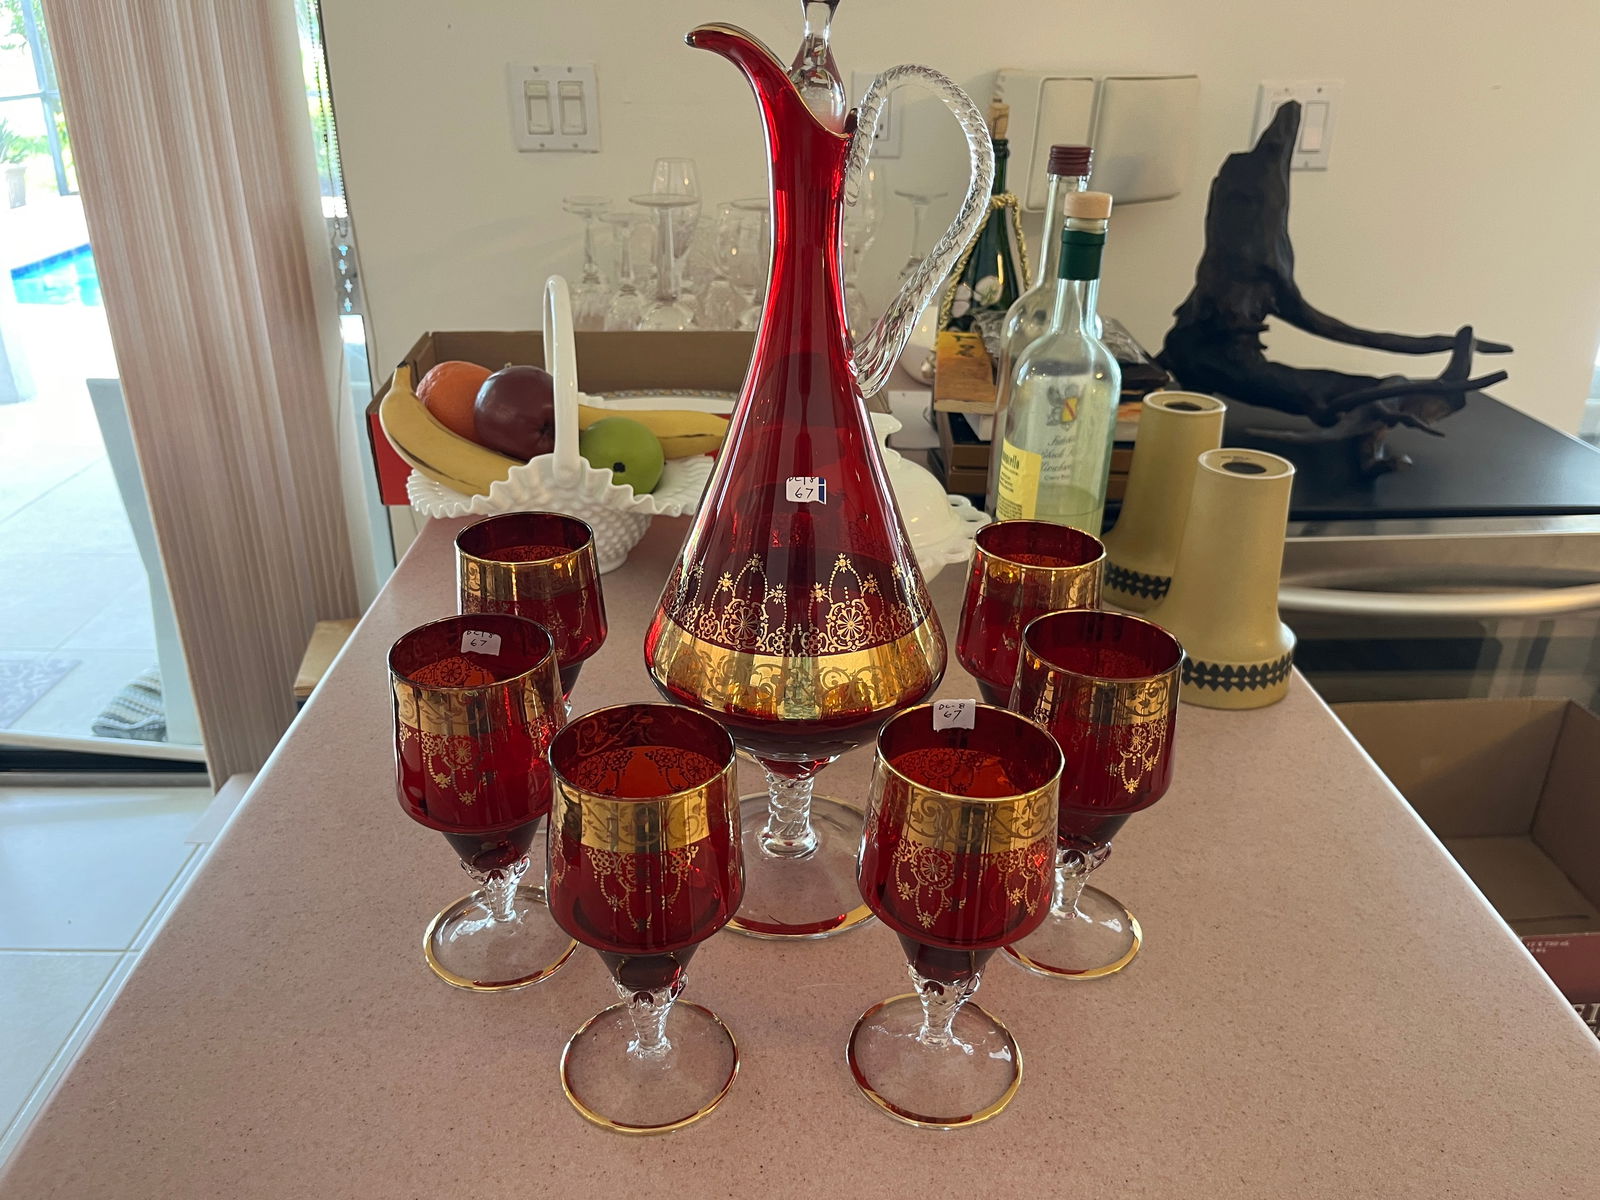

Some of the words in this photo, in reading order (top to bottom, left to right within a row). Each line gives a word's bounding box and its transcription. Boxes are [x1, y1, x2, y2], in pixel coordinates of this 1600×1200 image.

[795, 486, 814, 499] 67
[470, 638, 488, 647] 67
[943, 709, 962, 722] 67
